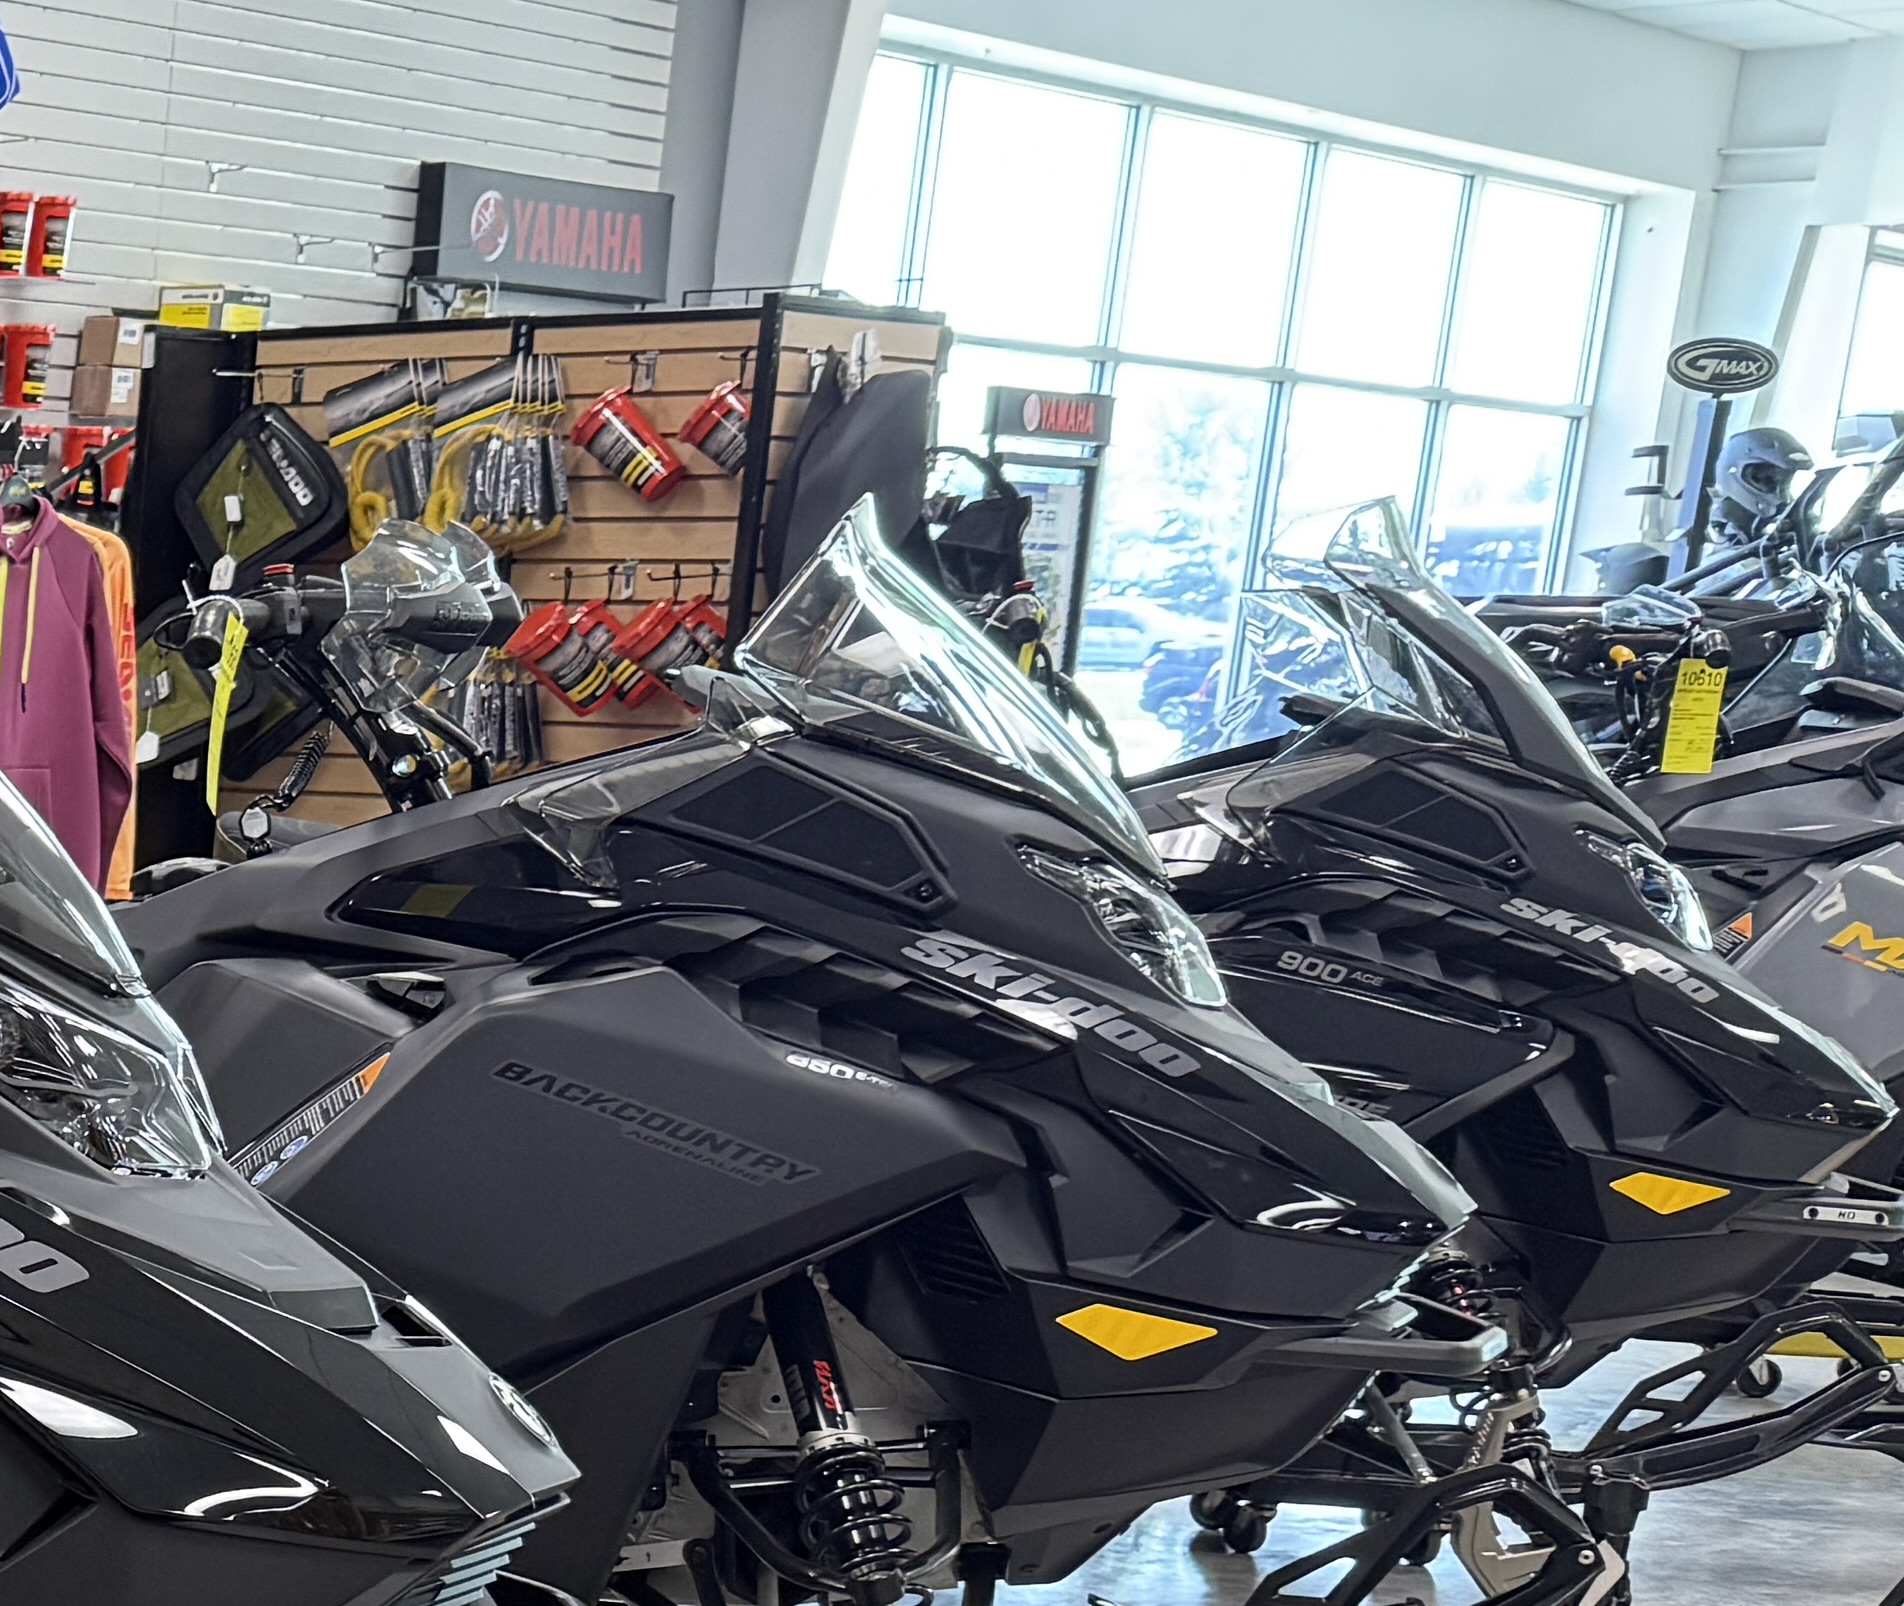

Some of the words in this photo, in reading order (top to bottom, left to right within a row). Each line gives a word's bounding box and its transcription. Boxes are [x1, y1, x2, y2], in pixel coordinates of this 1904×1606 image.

[511, 199, 642, 274] YAMAHA
[1678, 346, 1769, 381] GMAX
[1041, 398, 1094, 434] YAMAHA
[1277, 950, 1348, 984] 900
[1501, 897, 1719, 1004] ski-doo
[901, 937, 1201, 1078] ski-doo
[491, 1061, 817, 1184] BACKCOUNTRY
[628, 1128, 768, 1184] ADRENALINE
